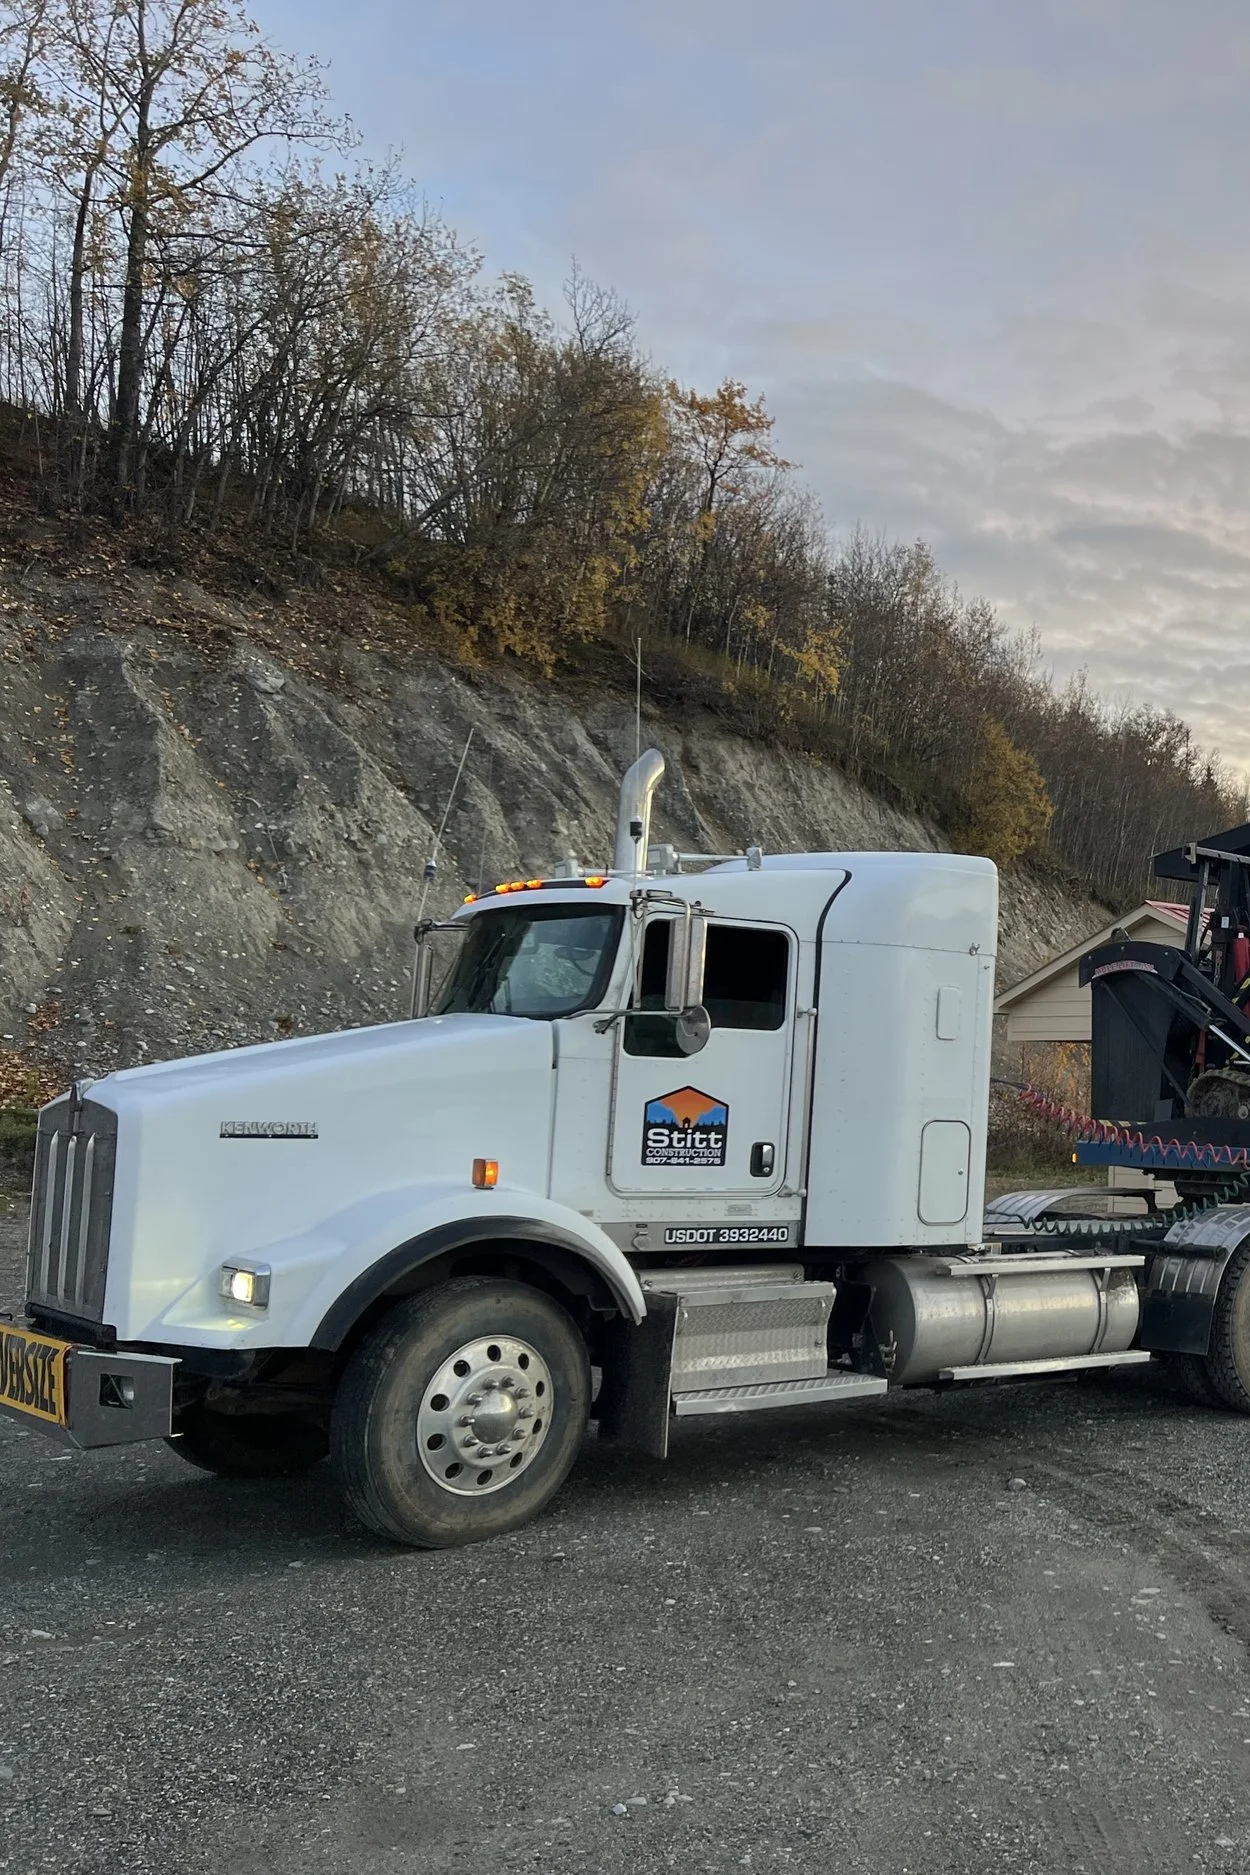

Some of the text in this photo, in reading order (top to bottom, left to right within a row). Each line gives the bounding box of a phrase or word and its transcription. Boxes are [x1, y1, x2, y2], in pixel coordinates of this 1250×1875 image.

[220, 1120, 318, 1135] KENWORTH
[646, 1128, 723, 1148] Stitt
[645, 1148, 721, 1157] CONSTRUCTION
[665, 1228, 788, 1243] USDOT 3932440
